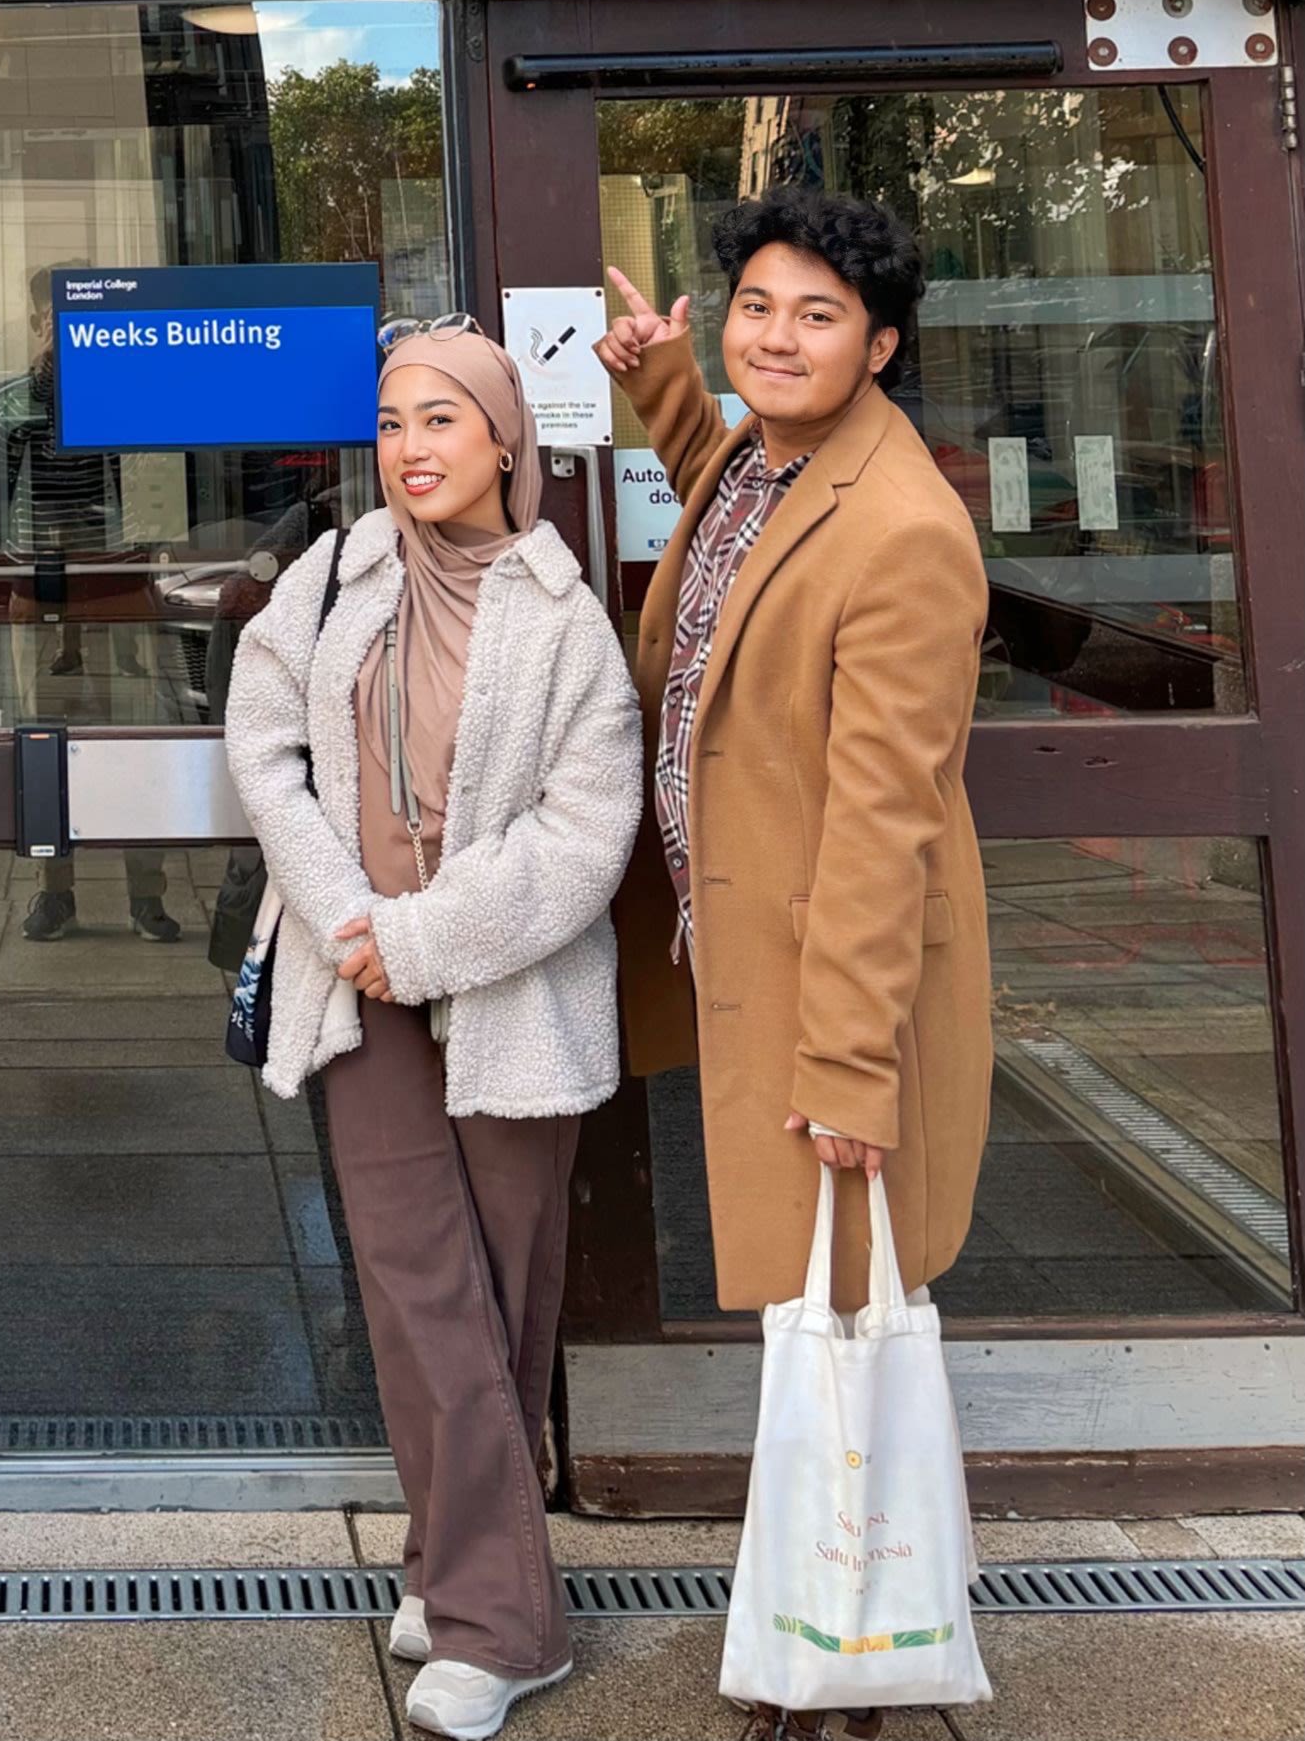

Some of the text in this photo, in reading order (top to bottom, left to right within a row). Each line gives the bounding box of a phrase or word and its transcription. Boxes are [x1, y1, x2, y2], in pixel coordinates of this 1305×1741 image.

[66, 279, 138, 292] Imperial College
[66, 291, 104, 301] London
[68, 319, 283, 350] Weeks Building
[537, 401, 567, 411] against
[568, 401, 581, 409] the
[582, 401, 597, 409] law
[562, 411, 571, 419] in
[572, 411, 595, 419] these
[541, 421, 579, 430] premises
